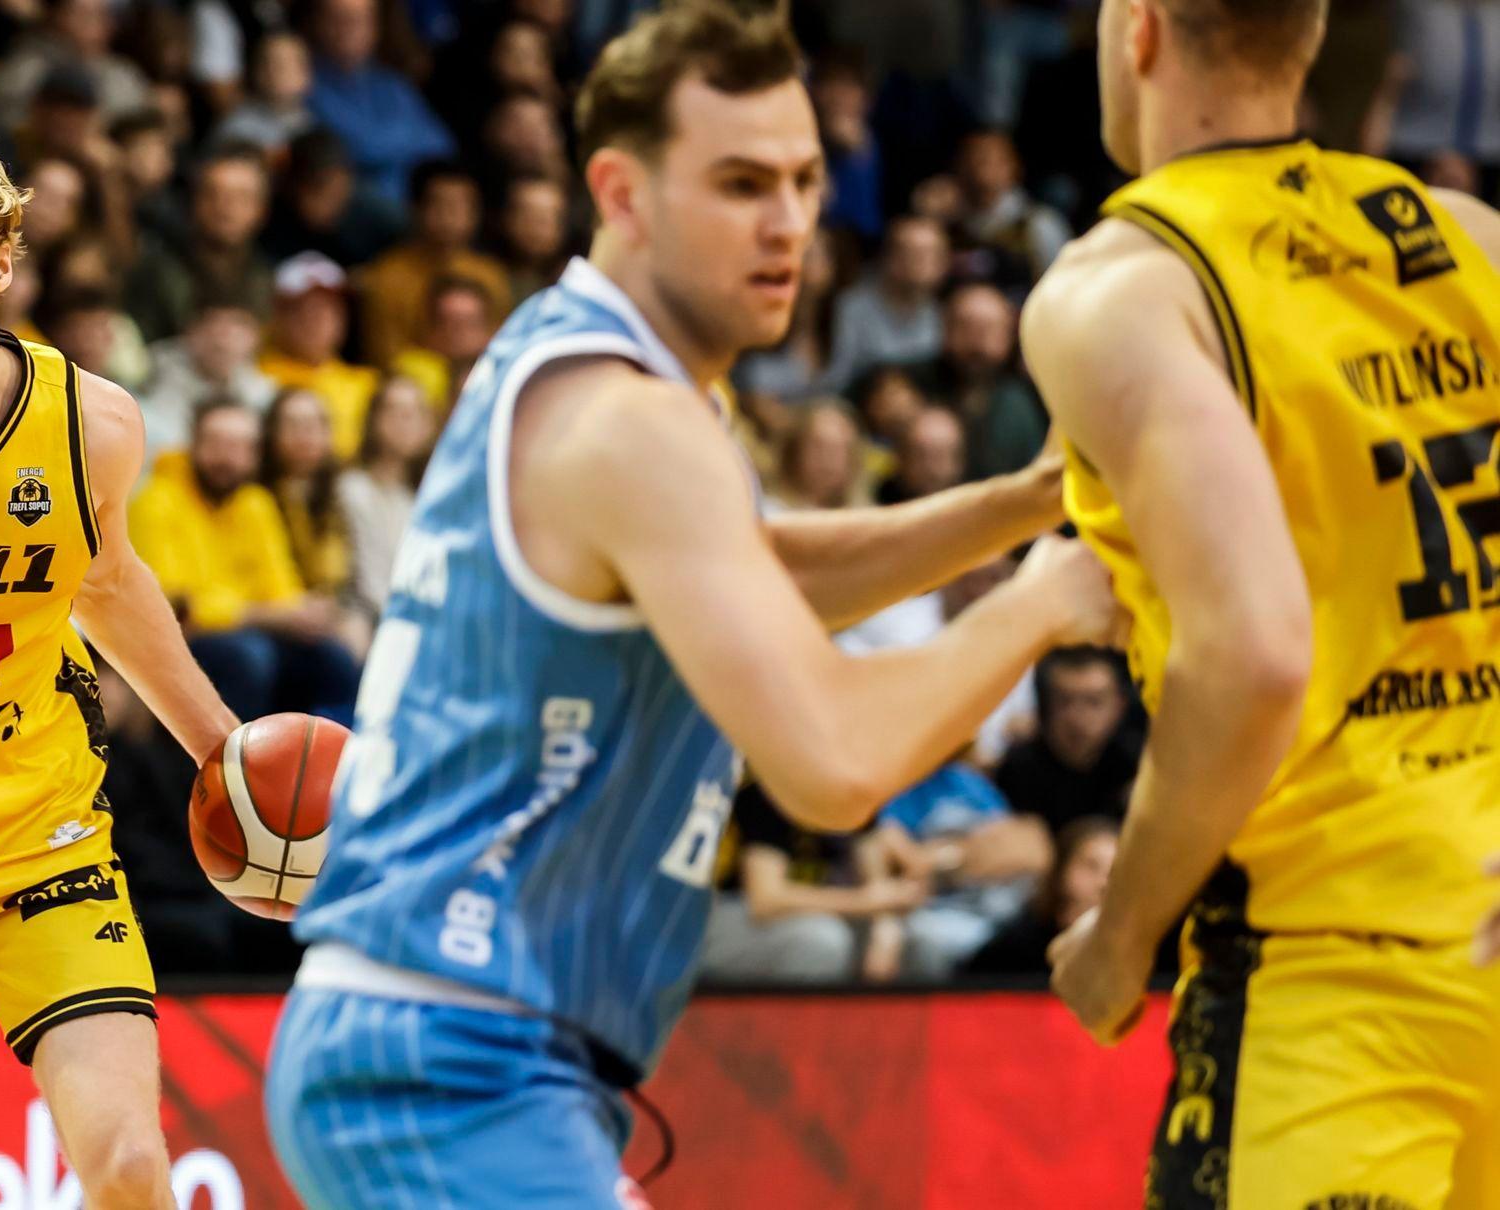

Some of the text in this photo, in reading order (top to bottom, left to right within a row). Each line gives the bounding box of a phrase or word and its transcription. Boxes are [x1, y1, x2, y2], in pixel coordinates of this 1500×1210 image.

[17, 466, 45, 479] ENERGA
[9, 501, 50, 513] TREFL SOPOT
[94, 920, 129, 943] 4F
